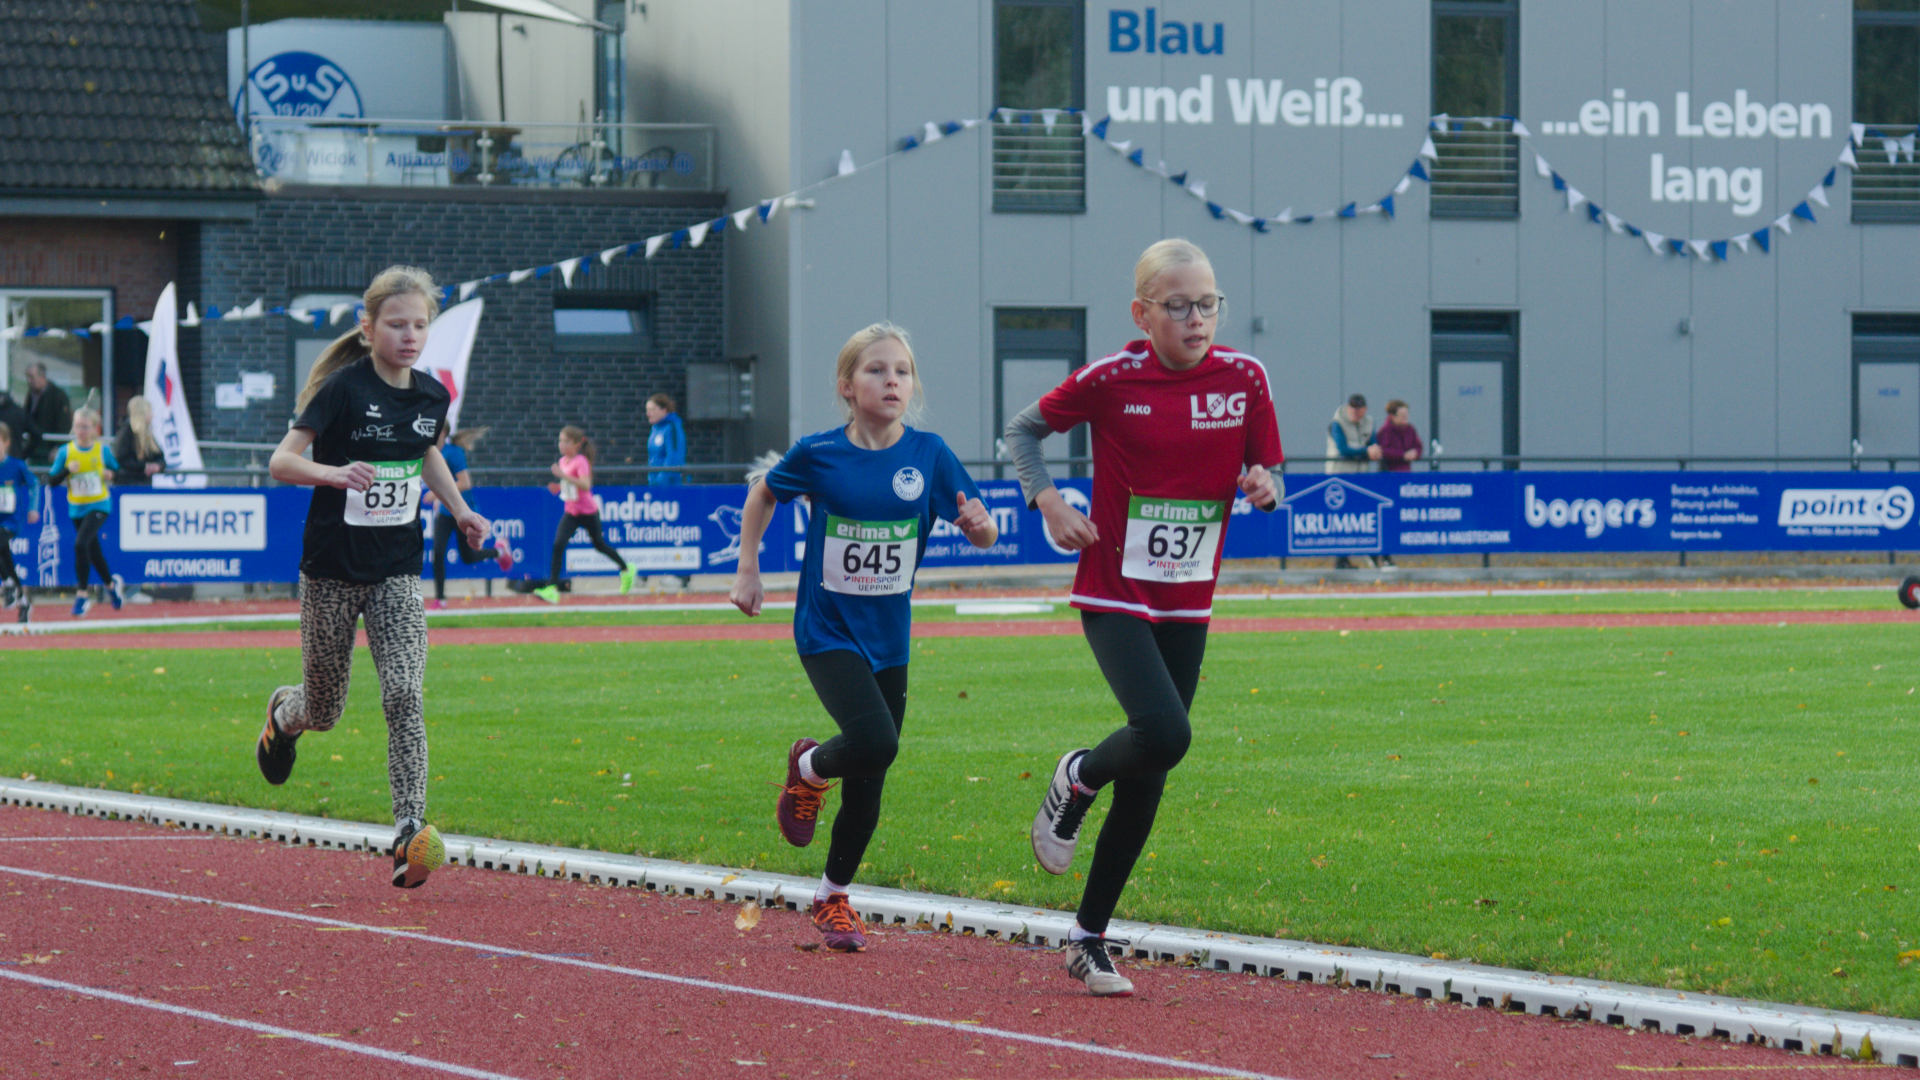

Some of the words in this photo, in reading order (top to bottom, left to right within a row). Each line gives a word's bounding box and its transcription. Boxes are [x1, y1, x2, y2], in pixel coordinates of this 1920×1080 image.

[1108, 8, 1224, 54] Blau
[1107, 75, 1213, 123] und
[1227, 77, 1403, 127] Weiß...
[1542, 89, 1660, 136] ...ein
[1675, 89, 1832, 138] Leben
[1651, 153, 1763, 215] lang
[1123, 403, 1151, 415] JAKO
[1191, 415, 1244, 430] Rosendahl
[375, 464, 405, 478] ima
[365, 481, 408, 509] 631
[592, 491, 679, 521] Andrieu
[1791, 495, 1866, 519] point
[130, 510, 254, 535] TERHART
[1141, 502, 1198, 520] erima
[1525, 484, 1656, 538] borgers
[623, 522, 701, 546] Toranlagen
[837, 523, 890, 540] erima
[1294, 512, 1377, 535] KRUMME
[1147, 524, 1206, 560] 637
[144, 558, 241, 577] AUTOMOBILE
[843, 543, 902, 574] 645
[1157, 560, 1200, 569] INTERSPORT
[851, 575, 902, 584] INTERSPORT
